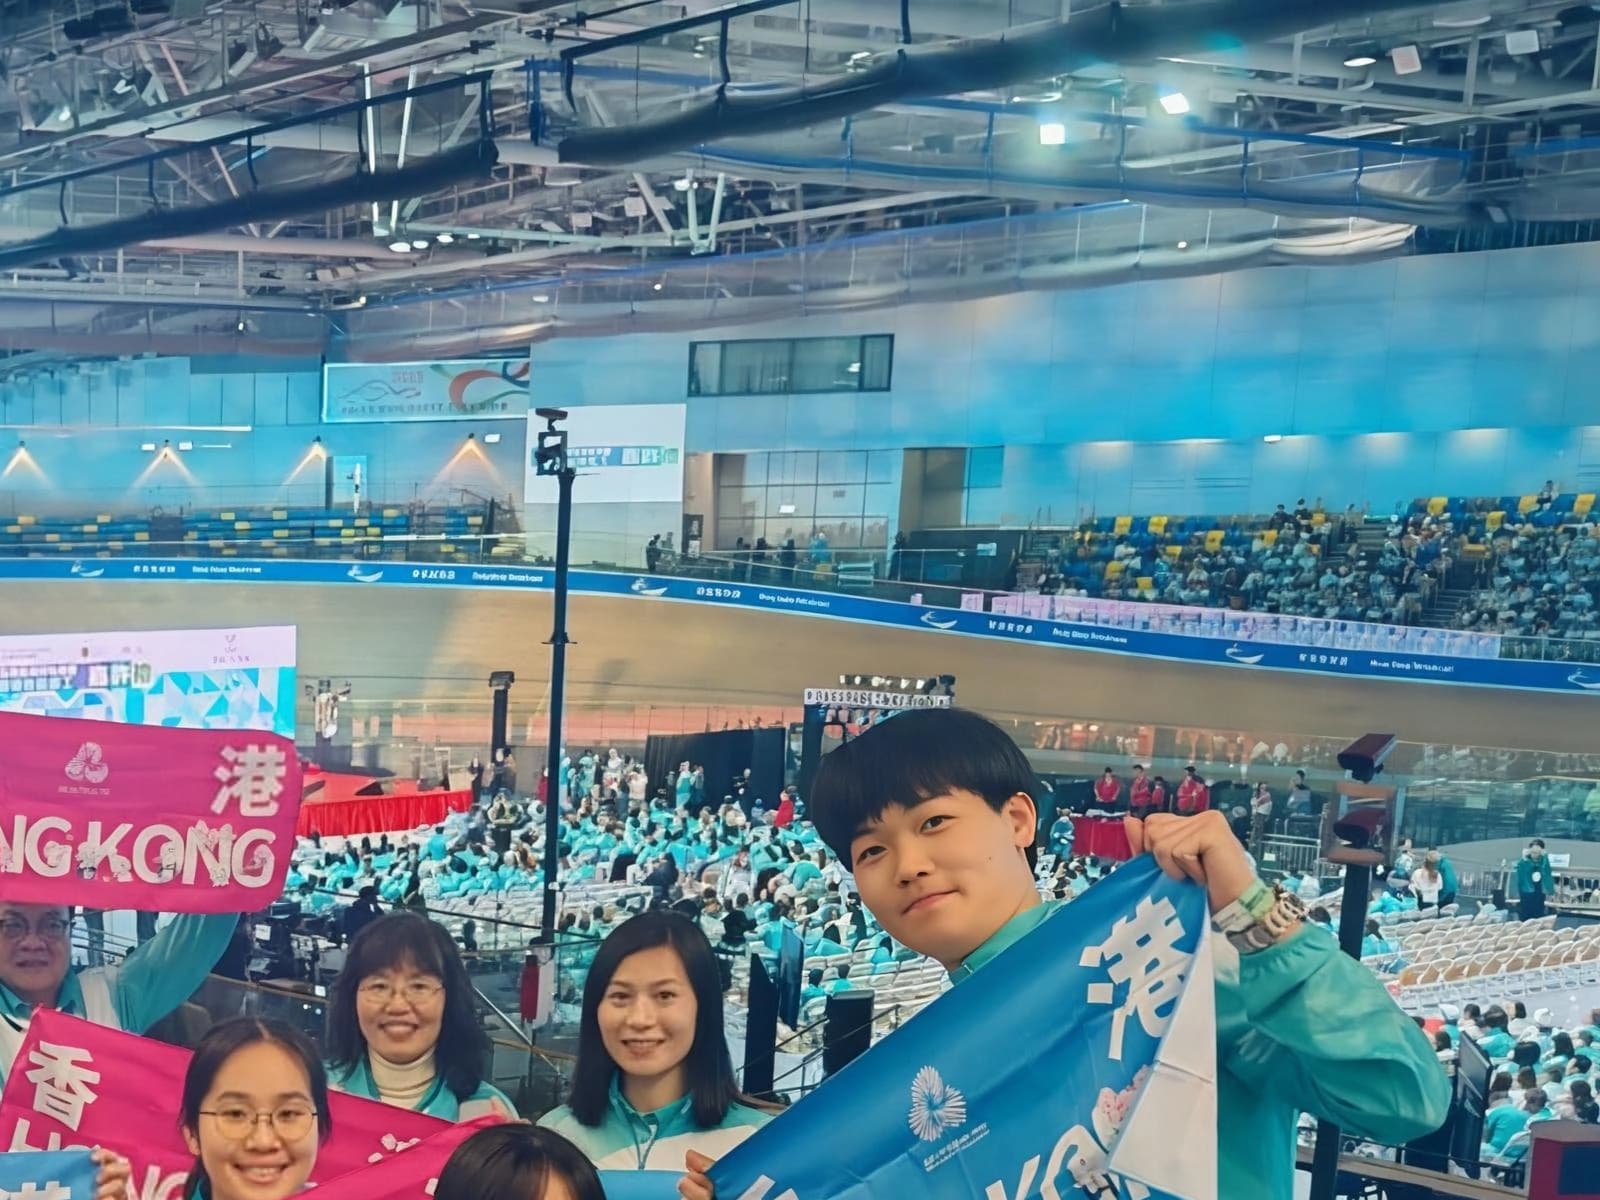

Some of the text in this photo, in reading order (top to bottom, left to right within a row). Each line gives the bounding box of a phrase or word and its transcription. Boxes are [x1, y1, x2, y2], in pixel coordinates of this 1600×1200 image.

[210, 744, 287, 817] 港
[1079, 895, 1196, 1061] 港
[26, 1040, 101, 1132] 香
